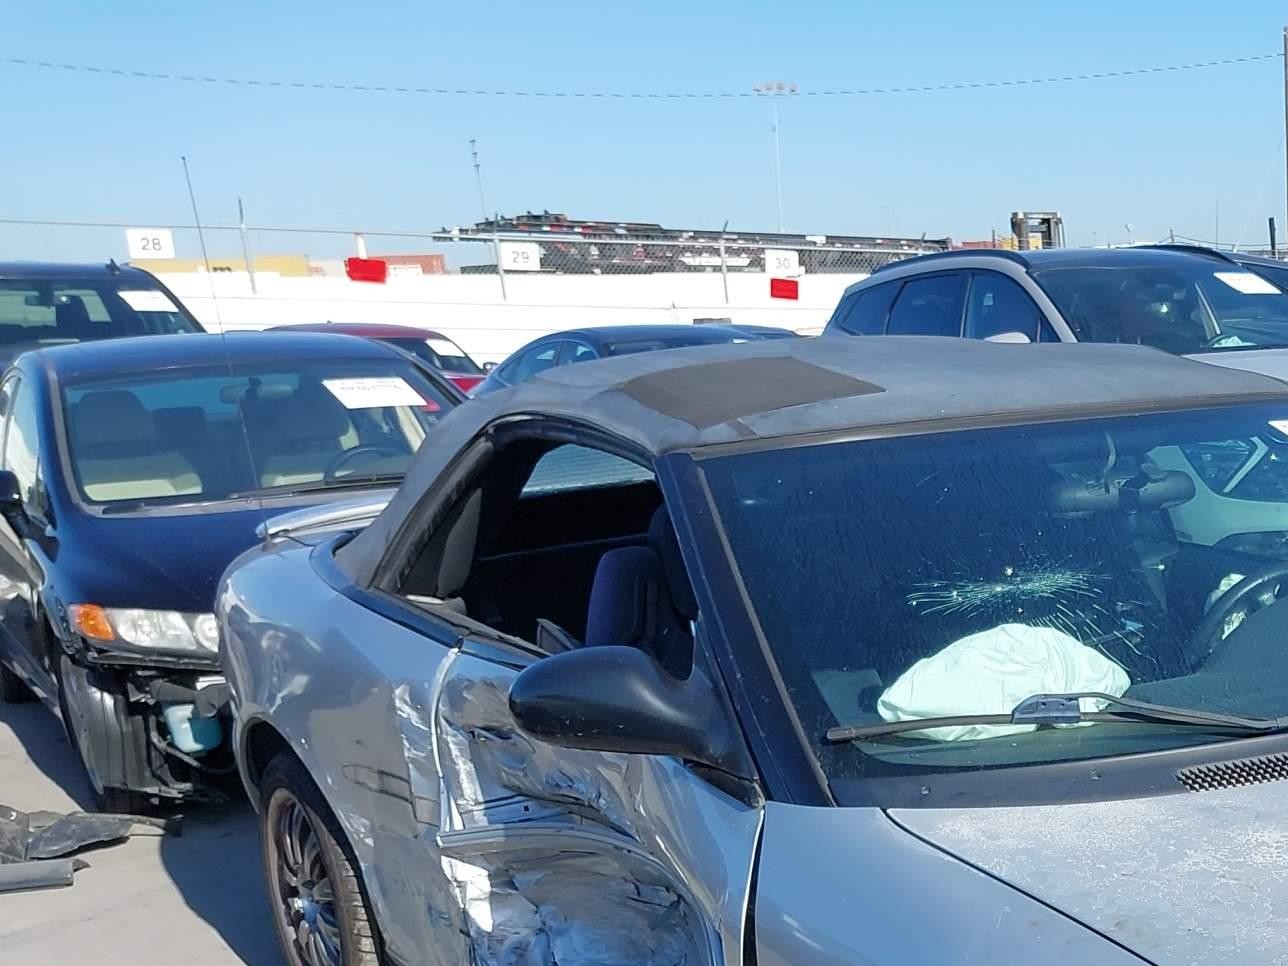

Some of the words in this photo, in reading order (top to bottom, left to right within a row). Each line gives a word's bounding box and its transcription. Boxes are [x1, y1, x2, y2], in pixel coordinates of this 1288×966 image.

[140, 237, 162, 251] 28
[511, 250, 530, 264] 29
[775, 257, 791, 270] 30
